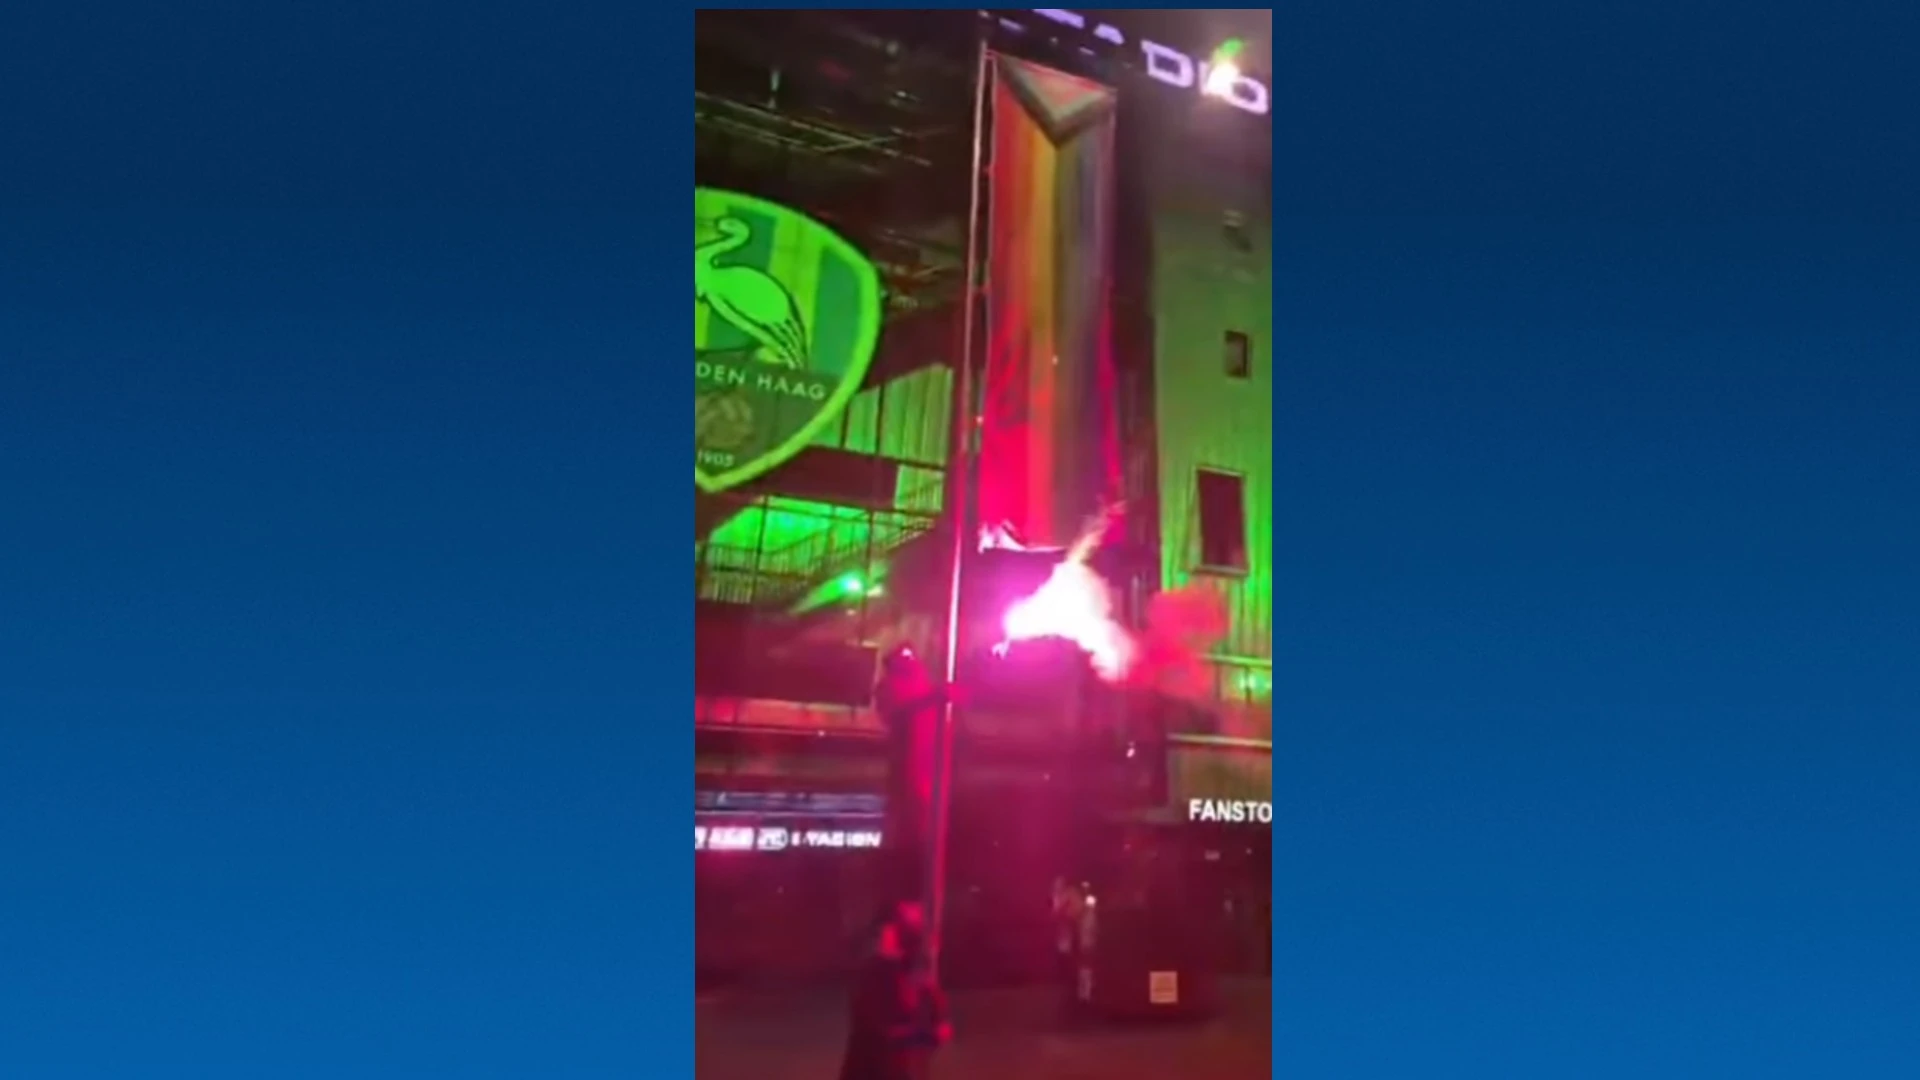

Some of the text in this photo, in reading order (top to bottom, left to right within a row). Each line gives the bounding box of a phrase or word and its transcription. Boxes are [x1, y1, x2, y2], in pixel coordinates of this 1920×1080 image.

[696, 361, 827, 400] DEN HAAG
[1189, 799, 1272, 823] FANSTO
